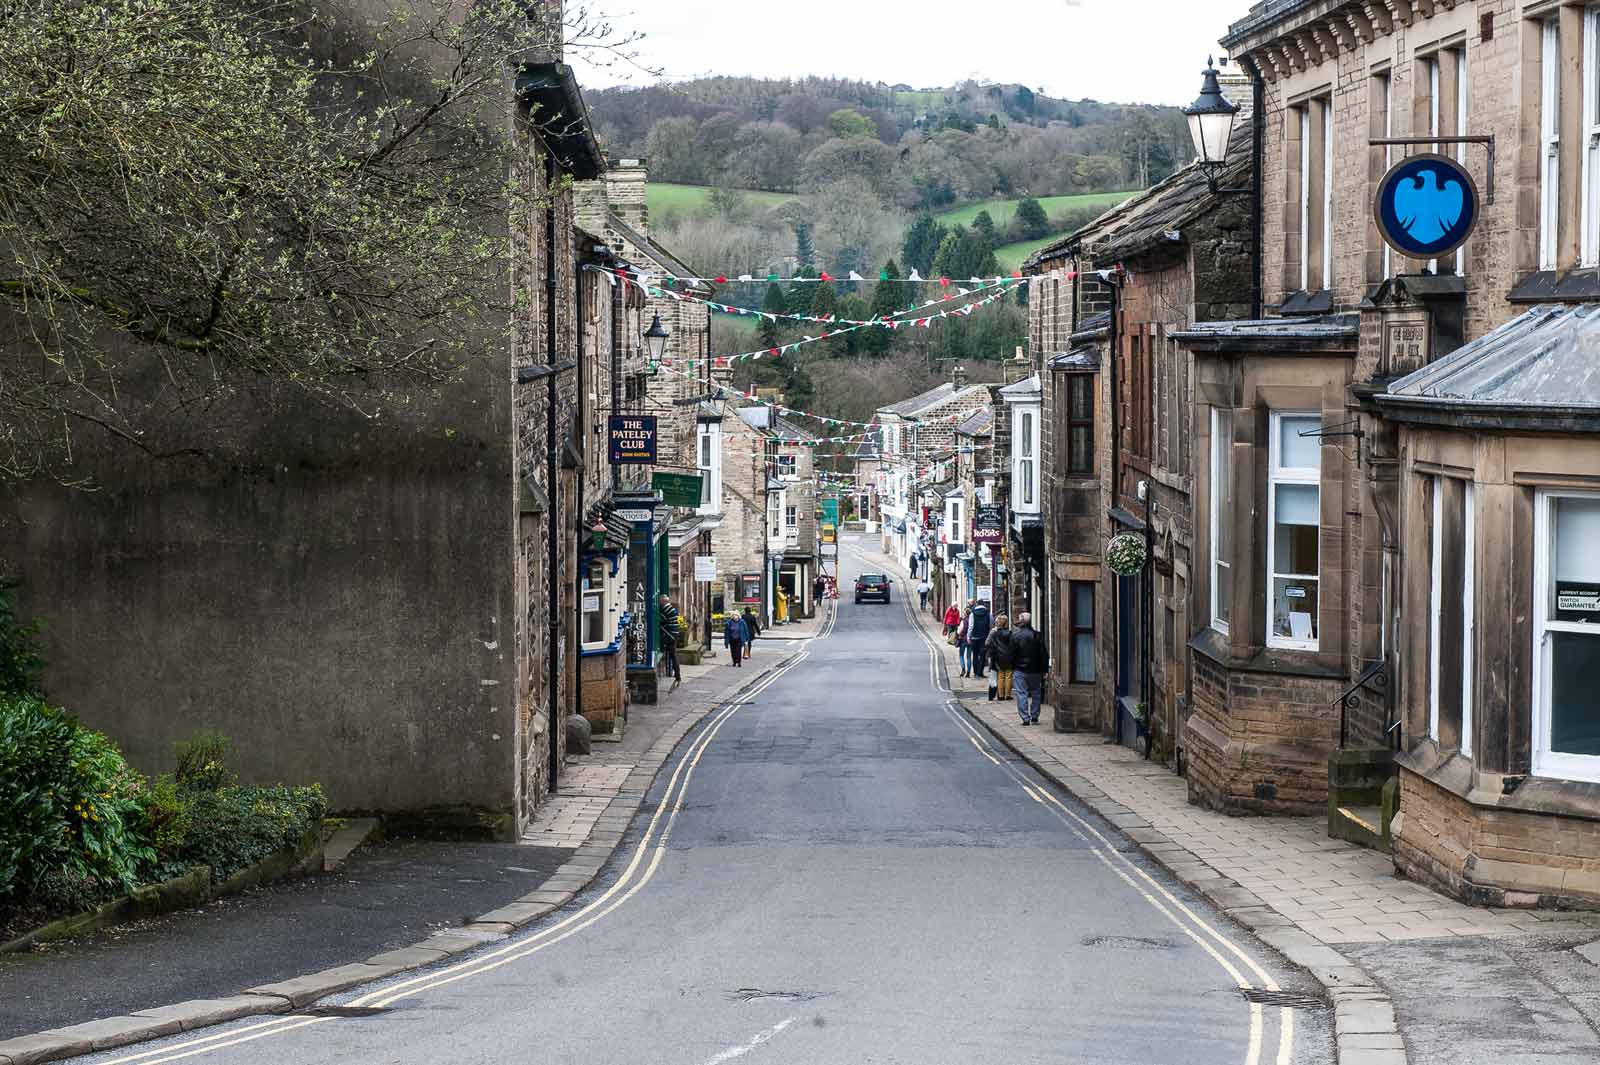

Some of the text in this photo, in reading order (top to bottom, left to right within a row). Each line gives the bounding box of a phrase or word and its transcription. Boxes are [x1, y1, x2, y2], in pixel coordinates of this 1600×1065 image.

[623, 421, 642, 429] THE
[612, 431, 652, 439] PATELEY
[620, 440, 645, 449] CLUB
[635, 582, 645, 660] ANTIQUES
